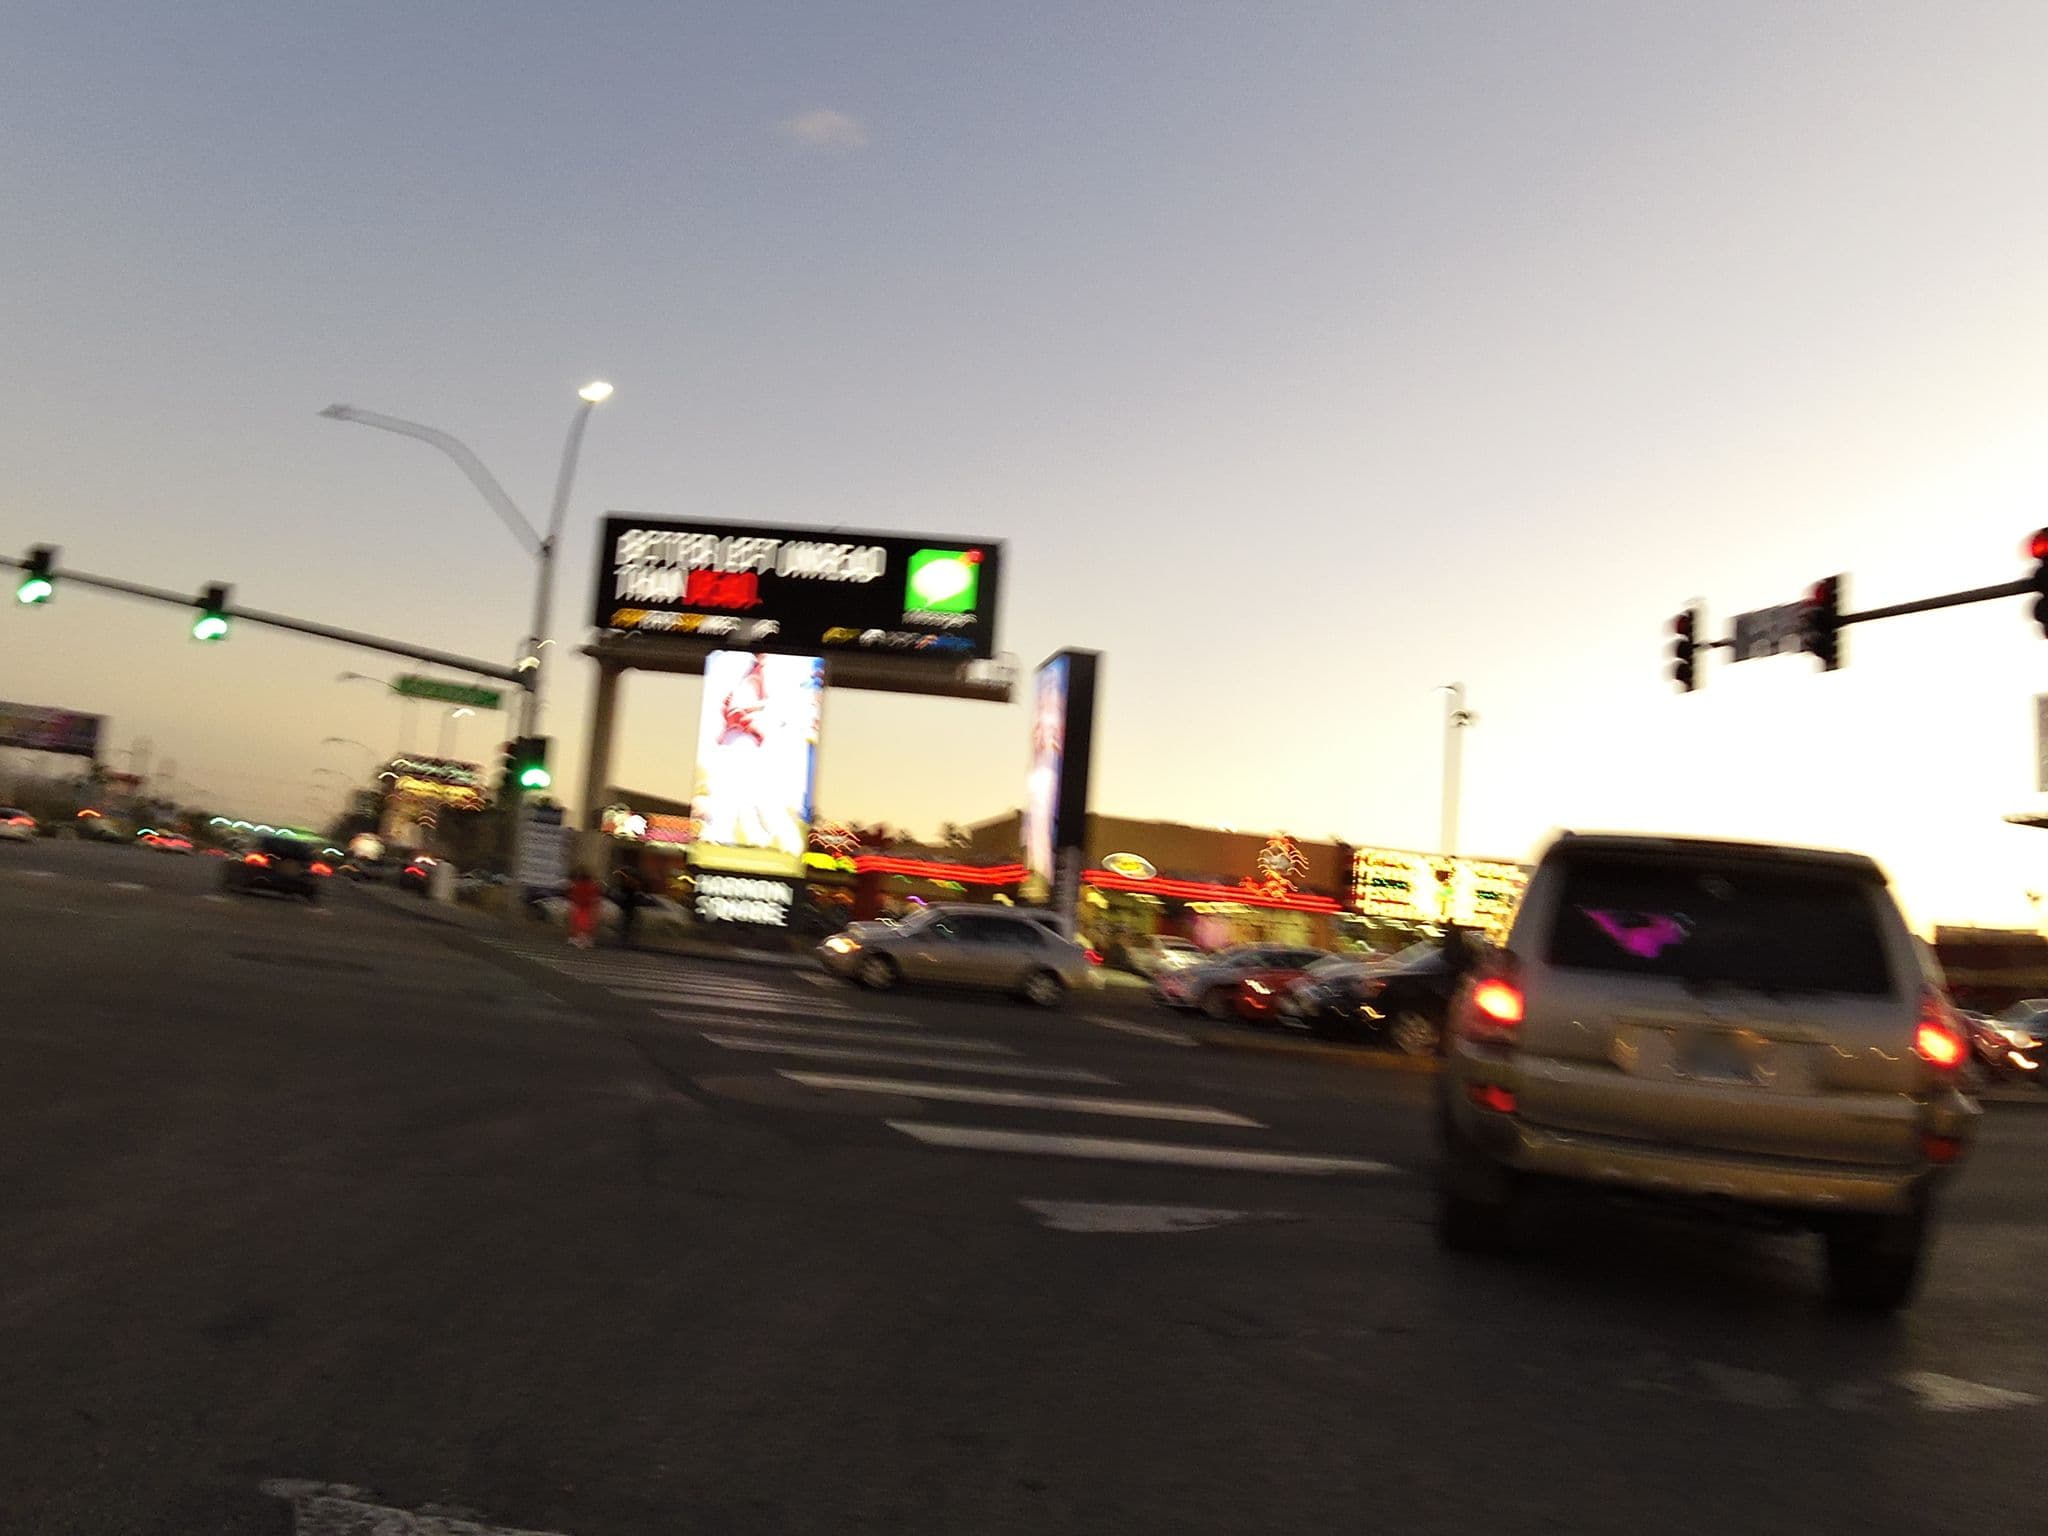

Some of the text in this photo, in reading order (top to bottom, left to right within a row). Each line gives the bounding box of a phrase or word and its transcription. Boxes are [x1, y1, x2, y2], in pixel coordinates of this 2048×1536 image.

[615, 528, 719, 571] BETTER
[714, 536, 782, 575] LEFT
[613, 564, 688, 603] THAN
